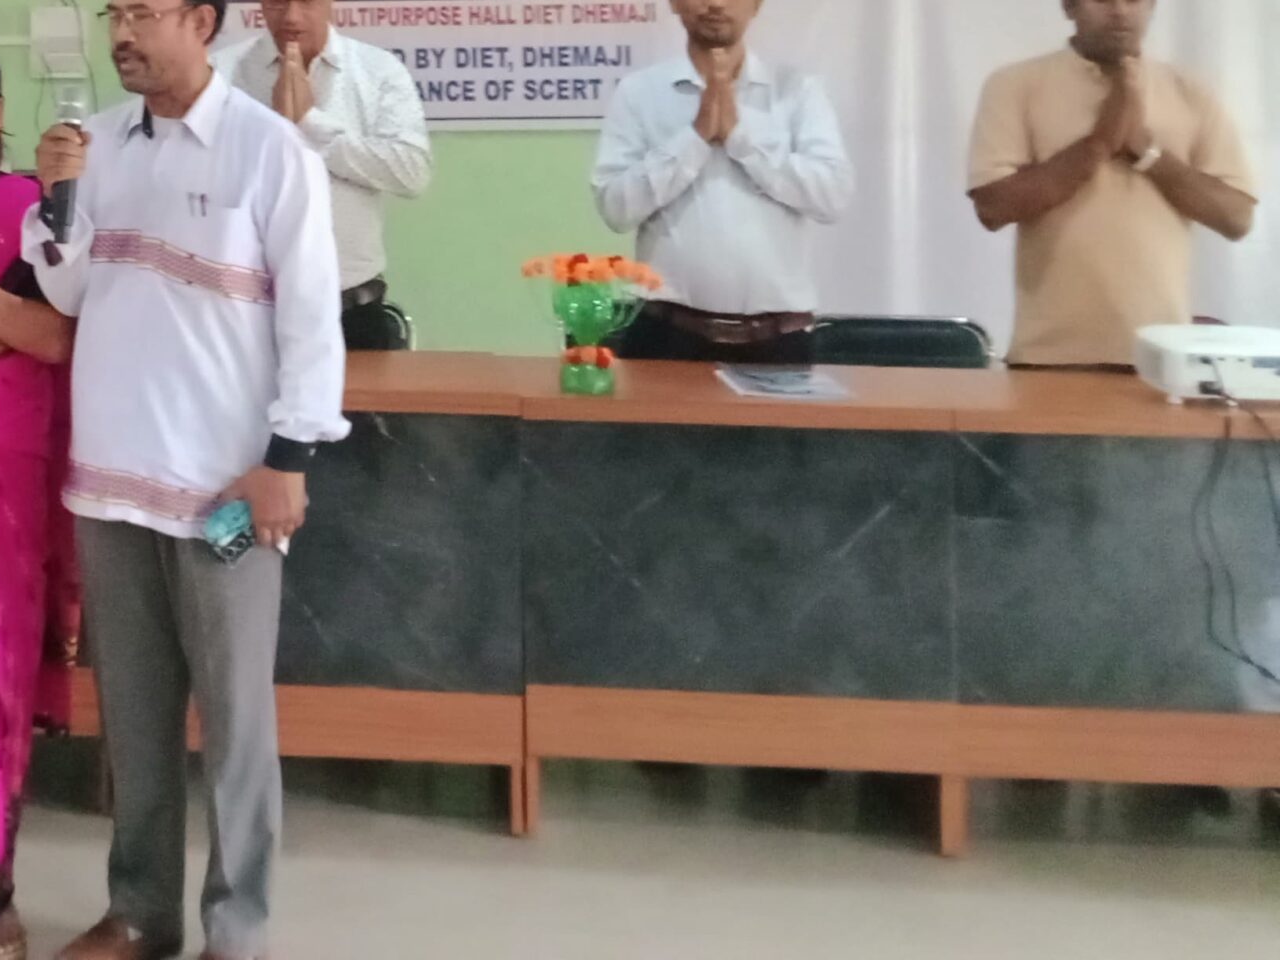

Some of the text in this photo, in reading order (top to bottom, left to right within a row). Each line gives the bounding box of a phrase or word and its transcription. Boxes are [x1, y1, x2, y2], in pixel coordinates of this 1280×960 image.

[327, 6, 462, 28] ULTIPURPOSE
[468, 5, 516, 26] HALL
[523, 4, 564, 25] DIET
[572, 2, 657, 24] DHEMAJI
[415, 47, 445, 69] BY
[455, 46, 514, 72] DIET,
[522, 45, 631, 68] DHEMAJI
[484, 79, 515, 101] OF
[523, 78, 602, 100] SCERT
